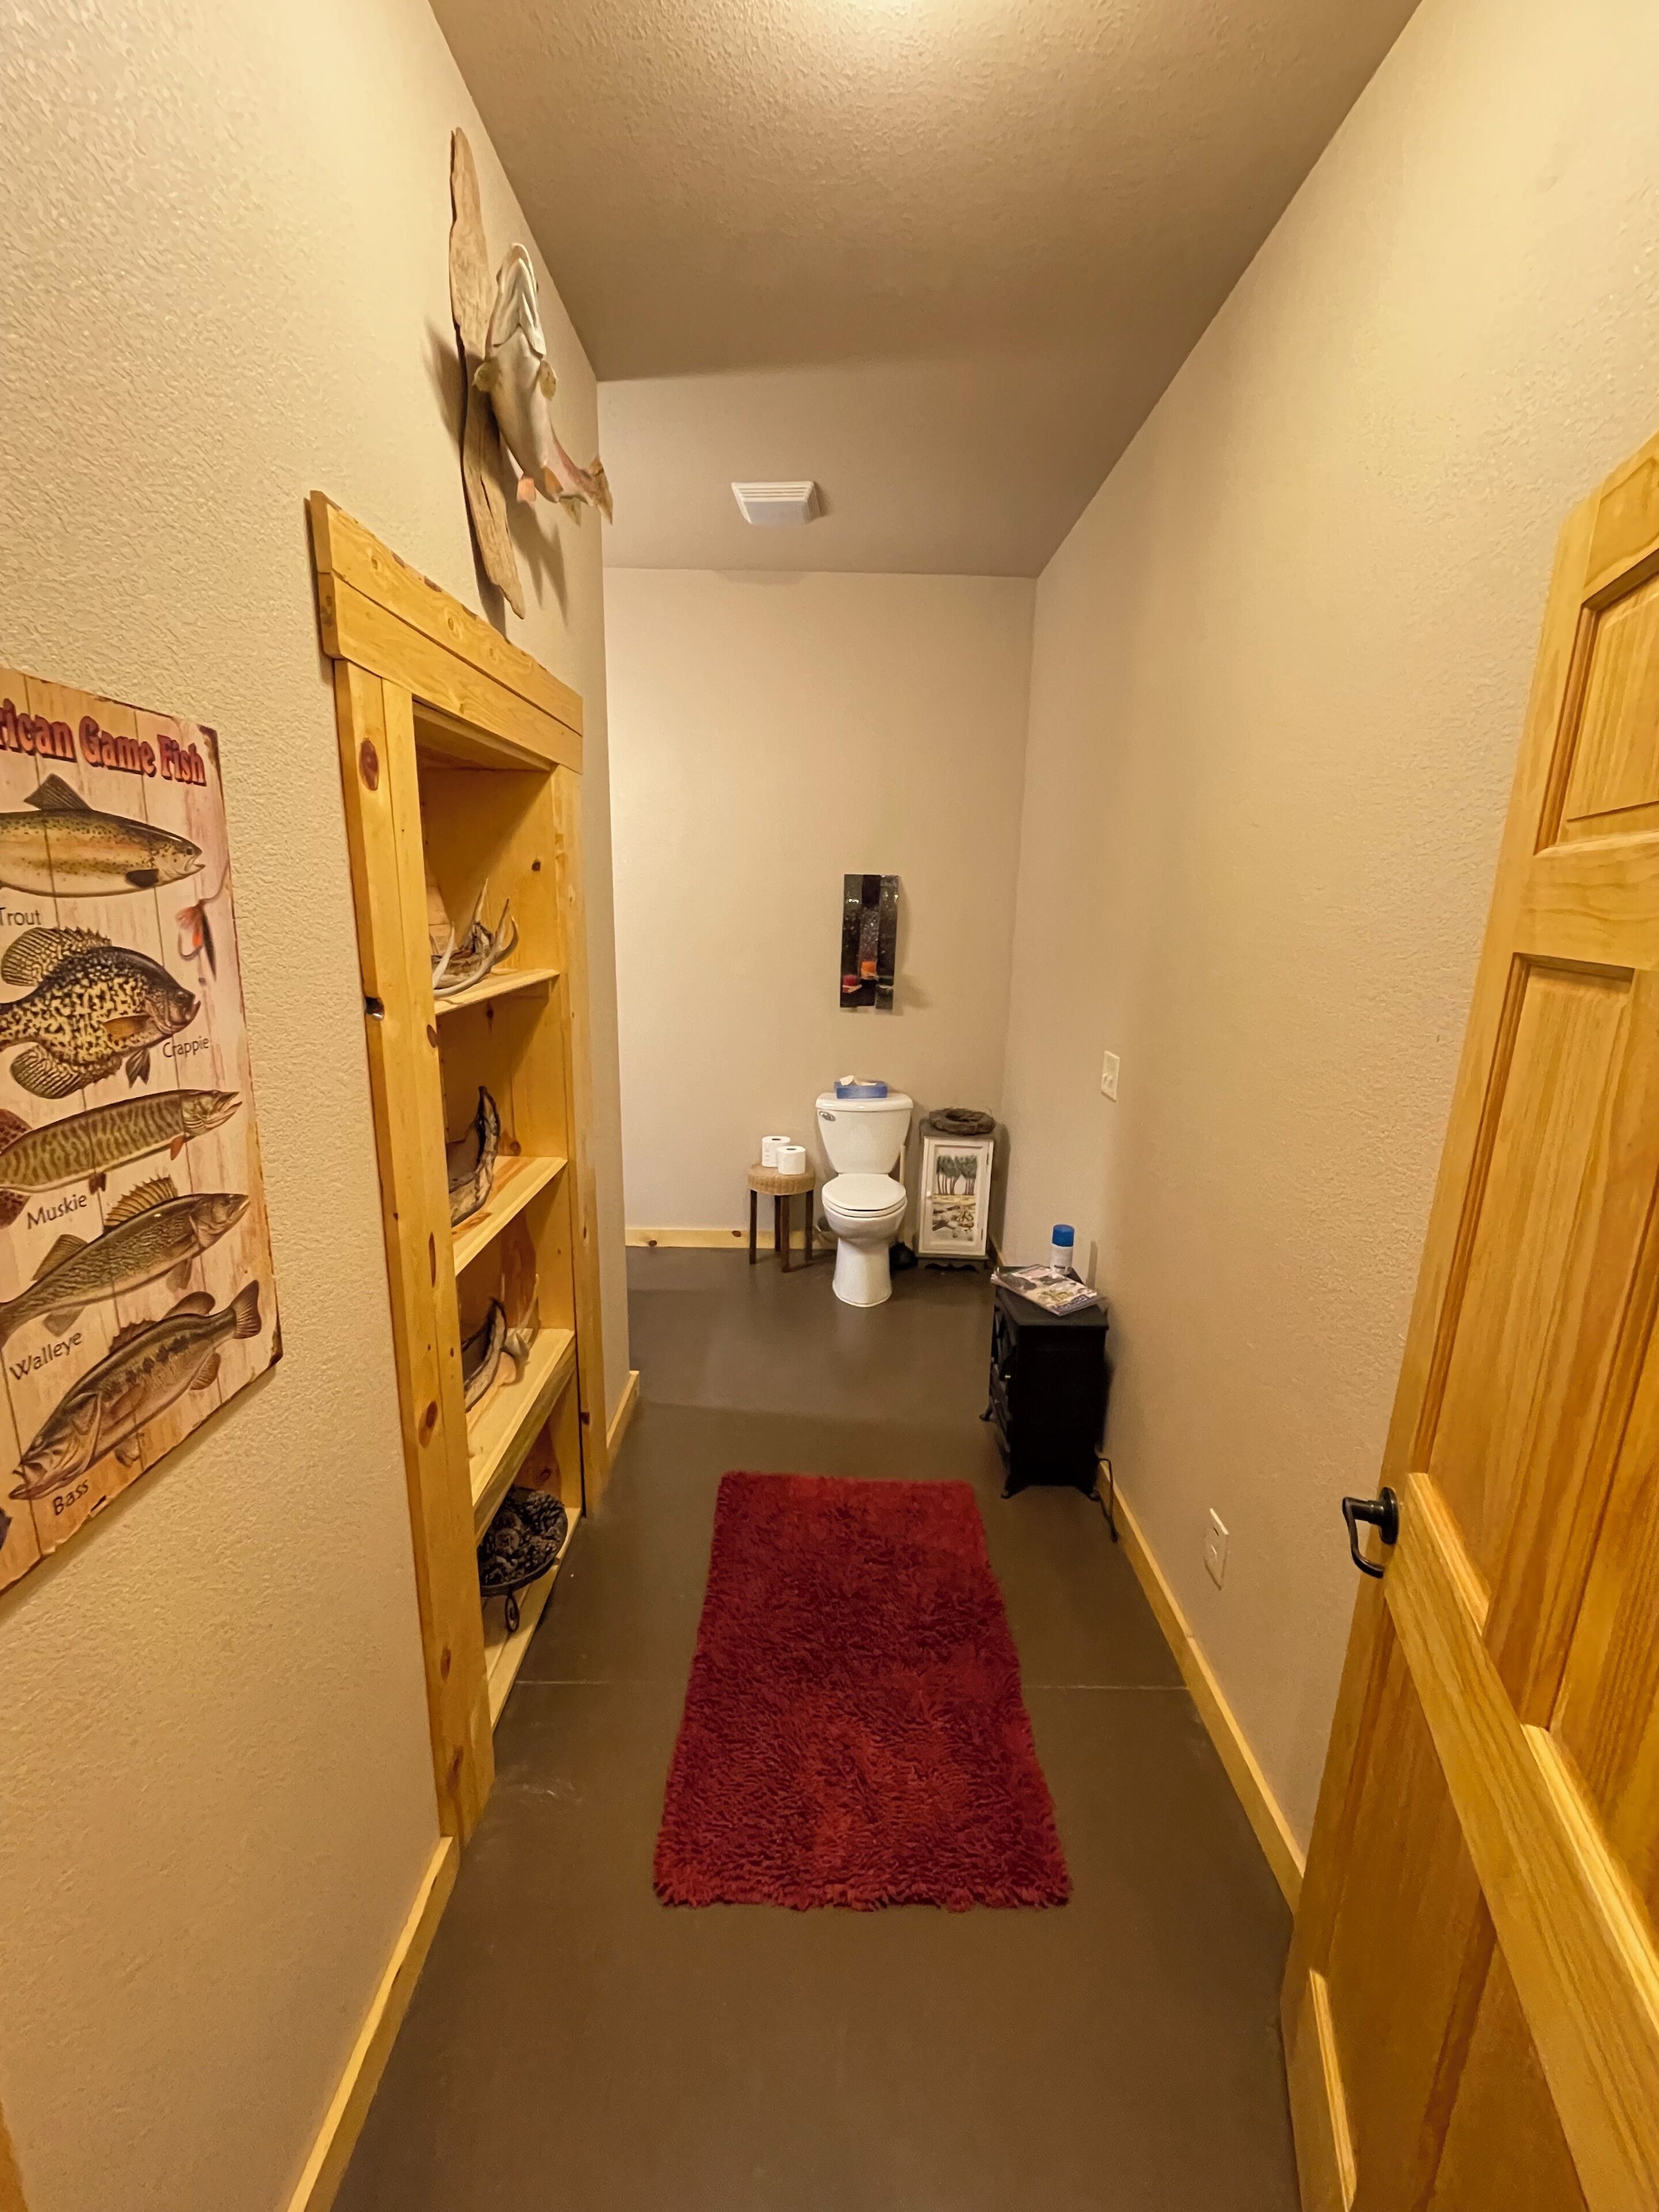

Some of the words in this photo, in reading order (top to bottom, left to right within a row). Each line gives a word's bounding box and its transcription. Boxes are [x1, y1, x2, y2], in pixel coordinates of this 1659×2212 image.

[79, 715, 157, 777] Game
[157, 734, 207, 787] Fish
[0, 907, 41, 926] Trout
[162, 1036, 209, 1058] Crappie
[27, 1194, 88, 1229] Muskie
[9, 1332, 82, 1380] Walleye
[53, 1479, 89, 1516] Bass
